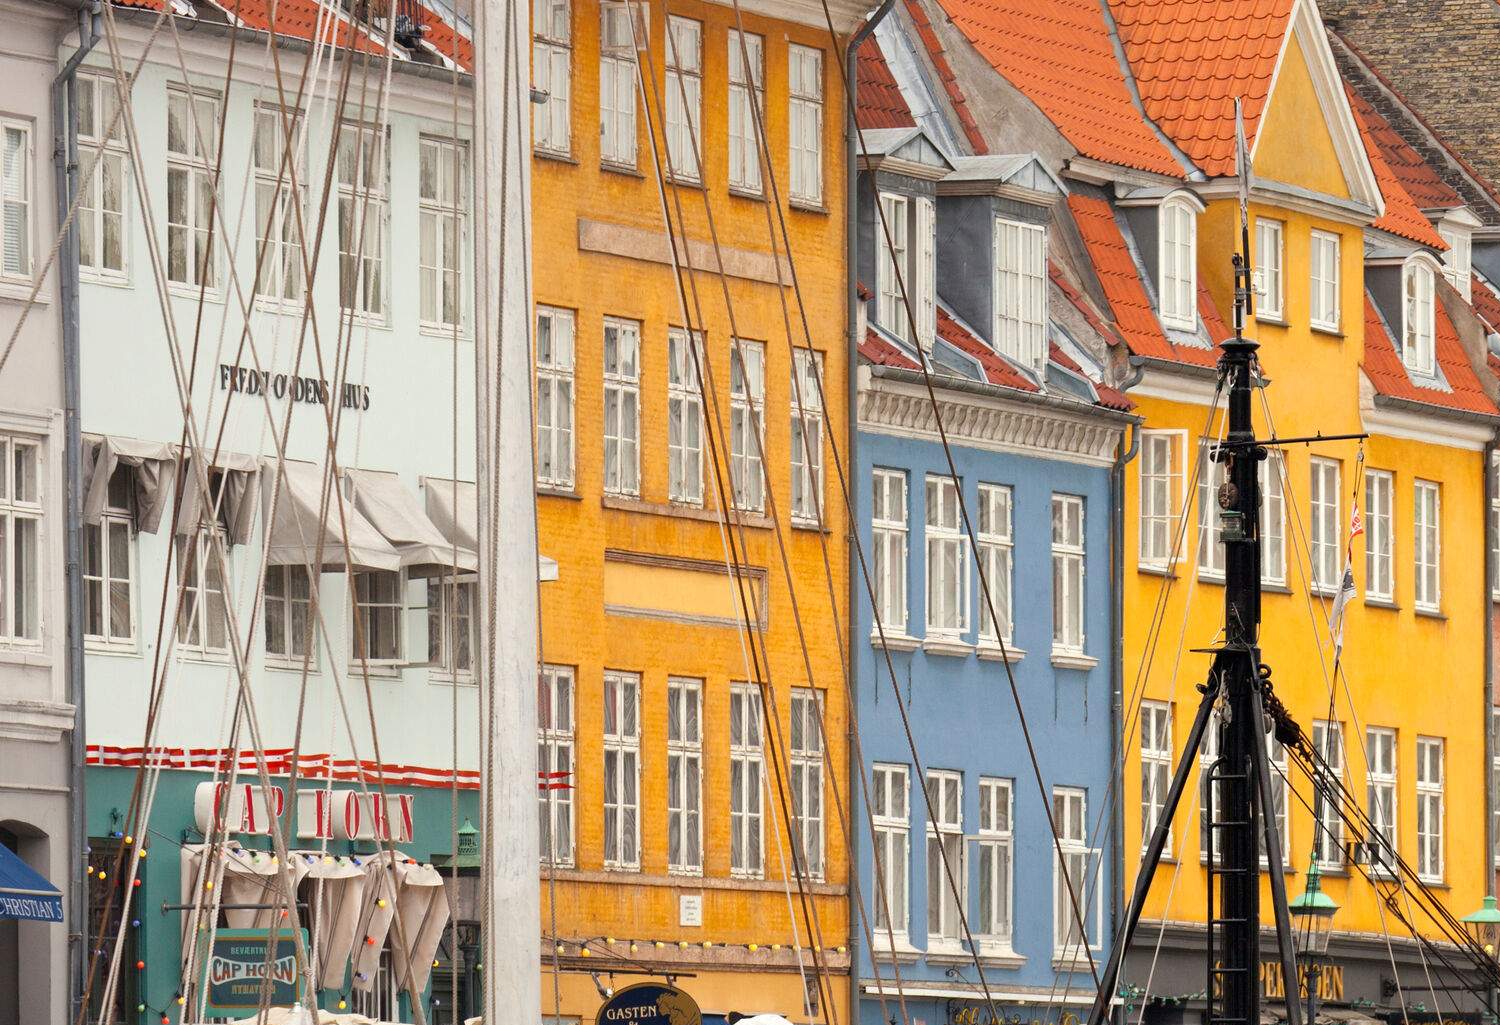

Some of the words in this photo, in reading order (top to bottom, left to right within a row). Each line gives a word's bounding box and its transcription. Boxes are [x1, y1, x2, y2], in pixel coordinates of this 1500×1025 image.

[341, 382, 370, 411] HUS
[212, 959, 242, 983] CAP
[245, 959, 293, 983] HORN
[606, 1005, 657, 1020] GASTEN
